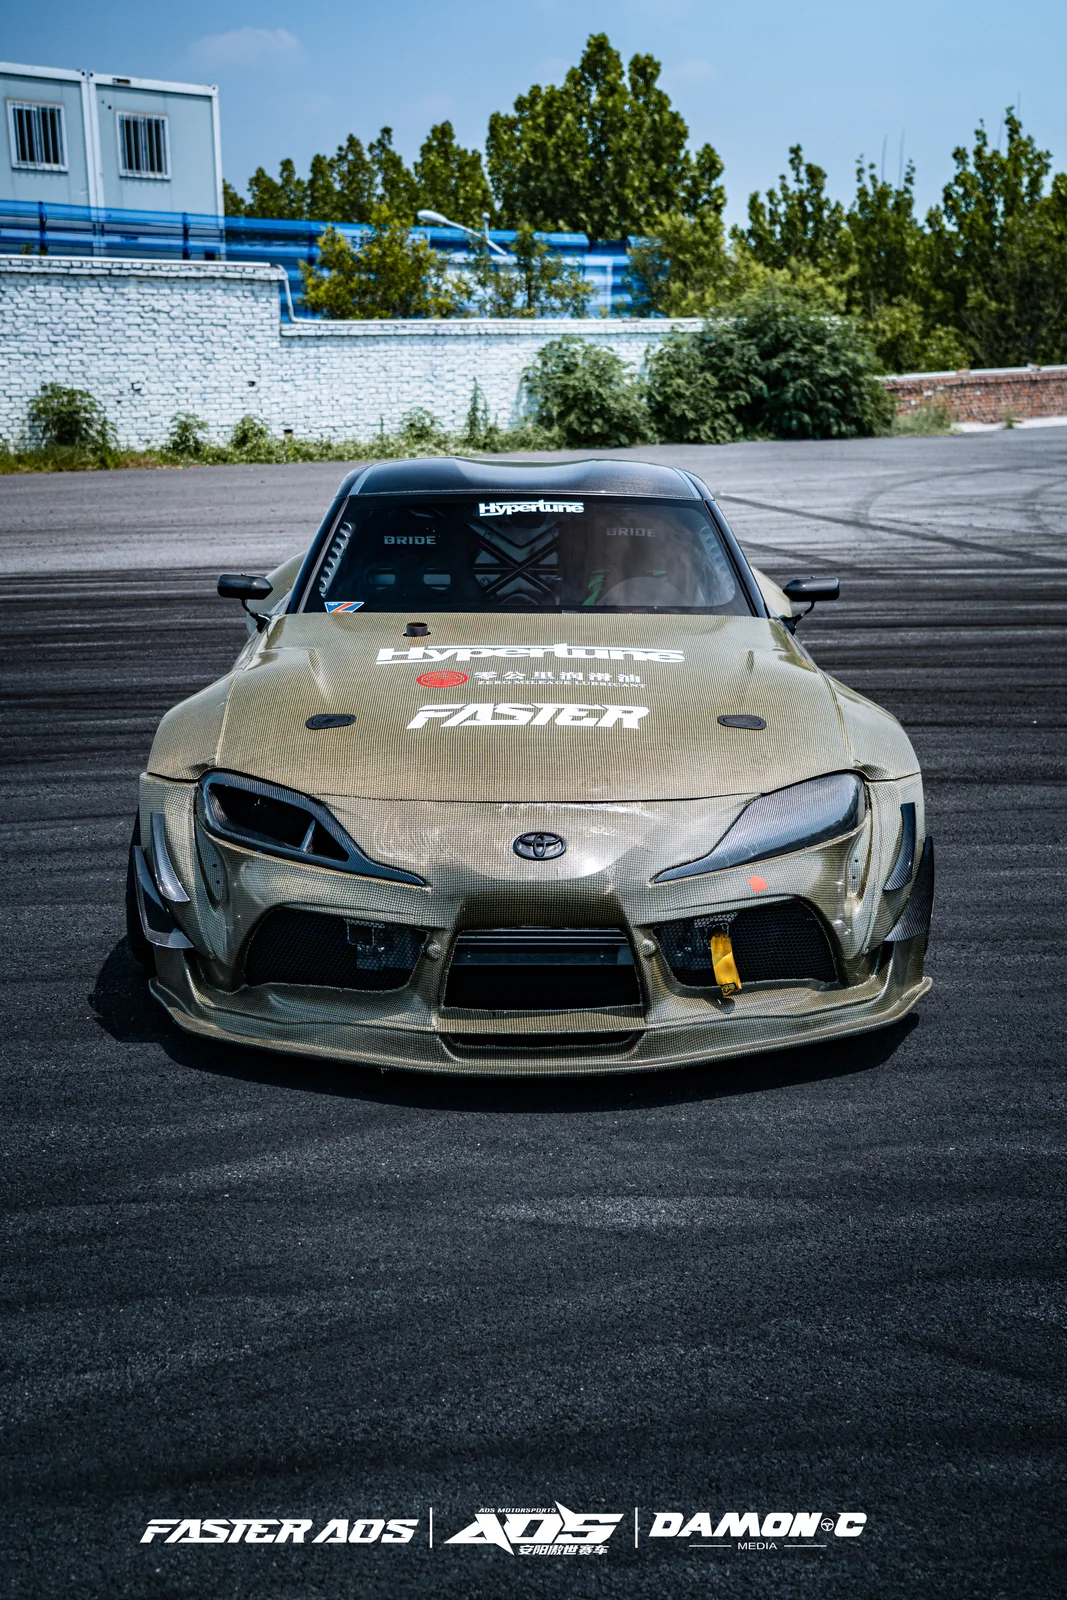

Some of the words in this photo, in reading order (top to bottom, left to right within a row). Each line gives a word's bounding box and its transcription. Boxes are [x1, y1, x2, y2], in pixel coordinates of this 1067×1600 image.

[479, 500, 584, 517] Hypertune
[606, 527, 658, 538] BRIDE
[384, 535, 437, 545] BRIDE
[376, 643, 685, 664] Hypertune
[575, 680, 646, 688] LUBRICANT
[406, 703, 650, 730] FASTER
